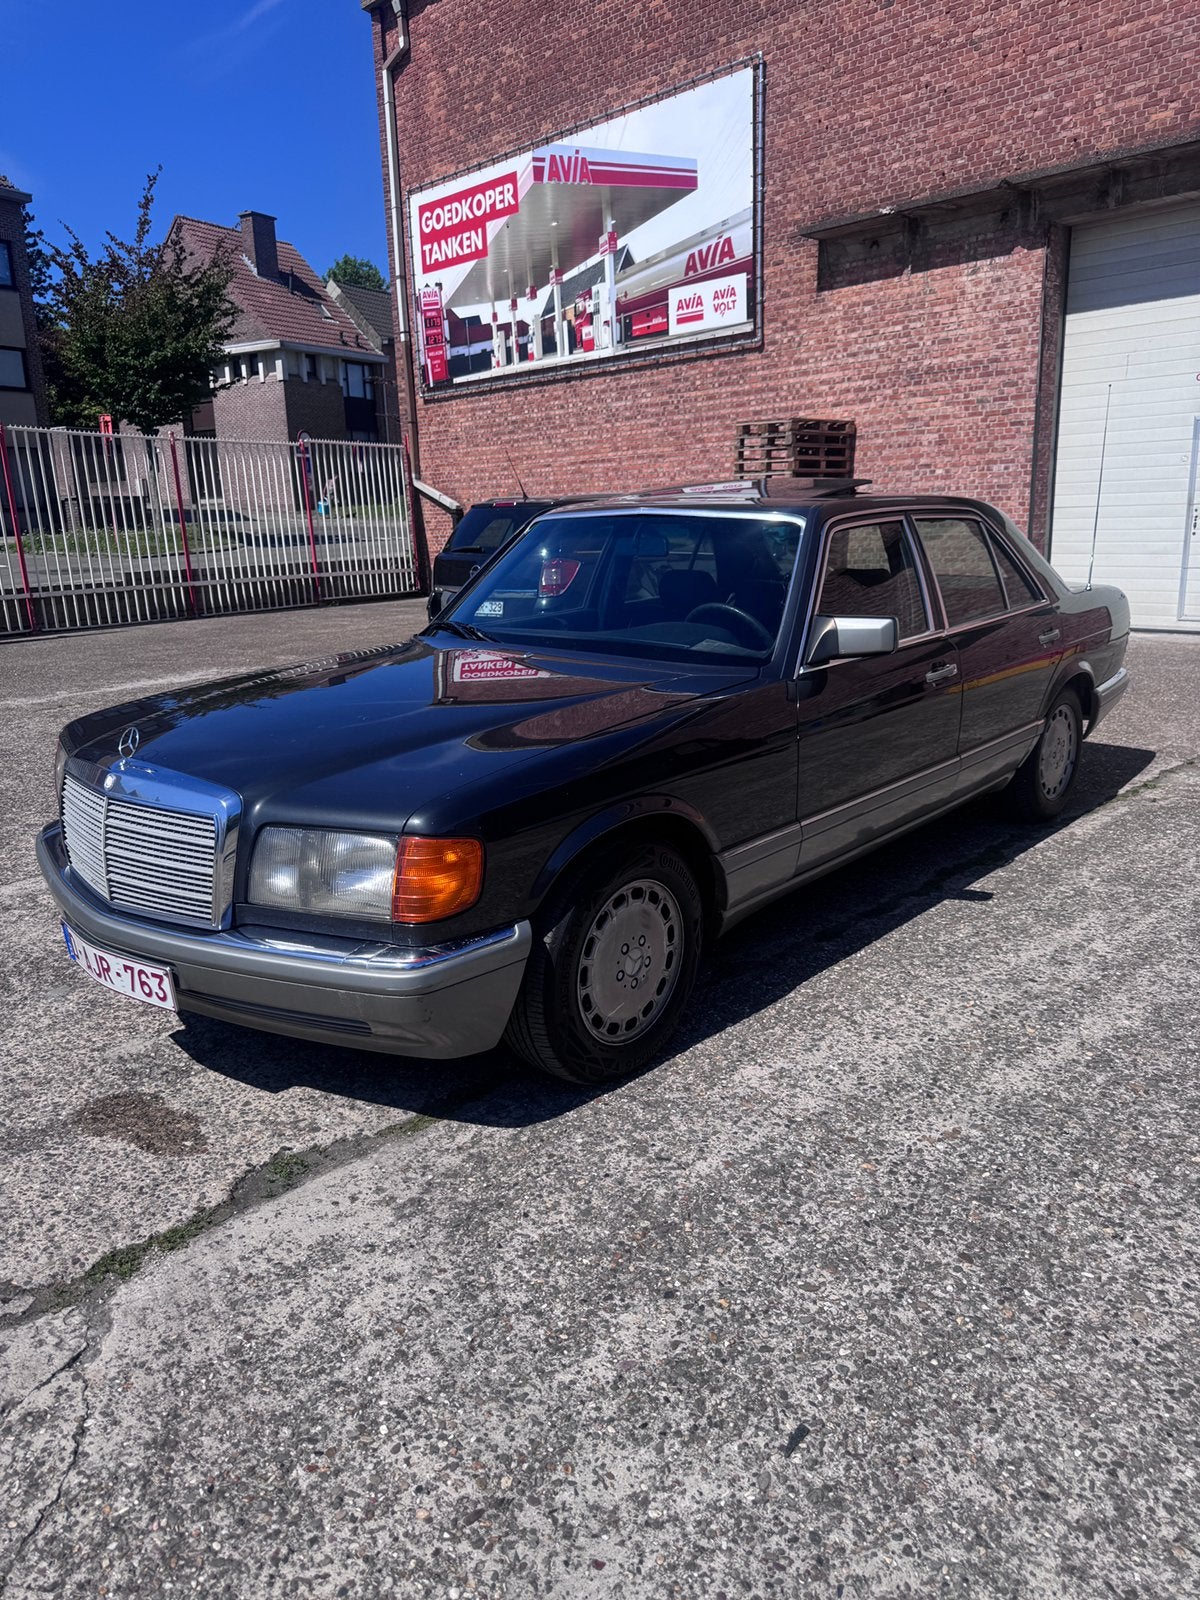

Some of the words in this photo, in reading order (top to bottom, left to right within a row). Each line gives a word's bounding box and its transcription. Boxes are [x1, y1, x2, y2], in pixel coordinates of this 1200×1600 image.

[421, 182, 516, 234] GOEDKOPER
[422, 227, 483, 266] TANKEN
[713, 299, 737, 316] VOLT
